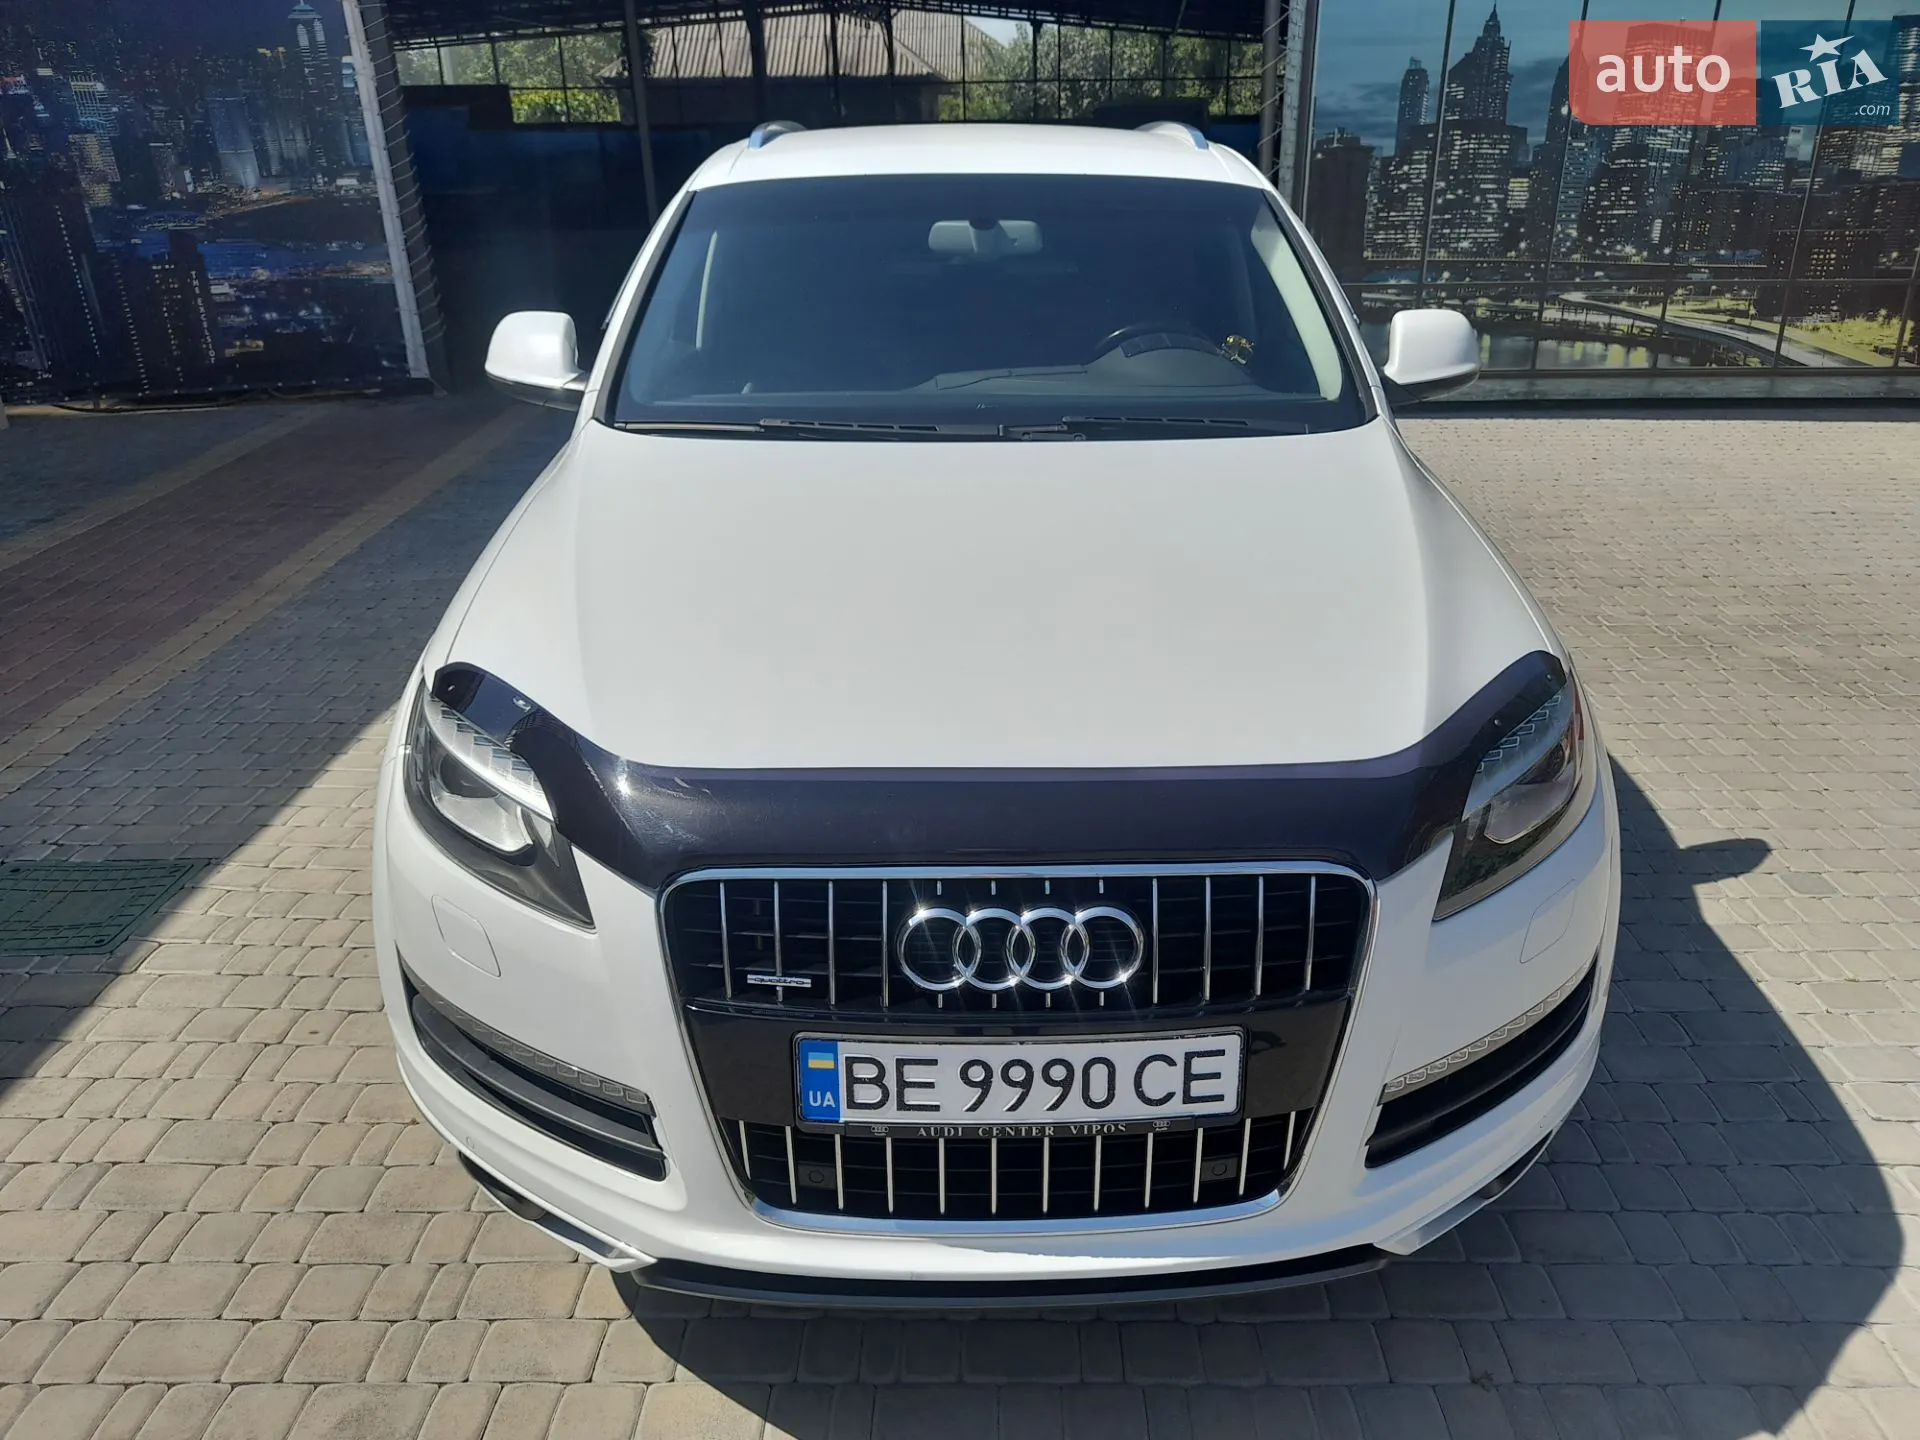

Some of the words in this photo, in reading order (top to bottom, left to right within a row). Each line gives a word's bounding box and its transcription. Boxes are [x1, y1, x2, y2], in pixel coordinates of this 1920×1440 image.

[844, 1055, 941, 1113] BE
[958, 1056, 1116, 1113] 9990
[1133, 1048, 1226, 1107] CE
[809, 1091, 836, 1109] UA
[917, 1126, 963, 1137] AUDI
[978, 1125, 1056, 1137] CENTER
[1070, 1122, 1127, 1136] VIPOS
